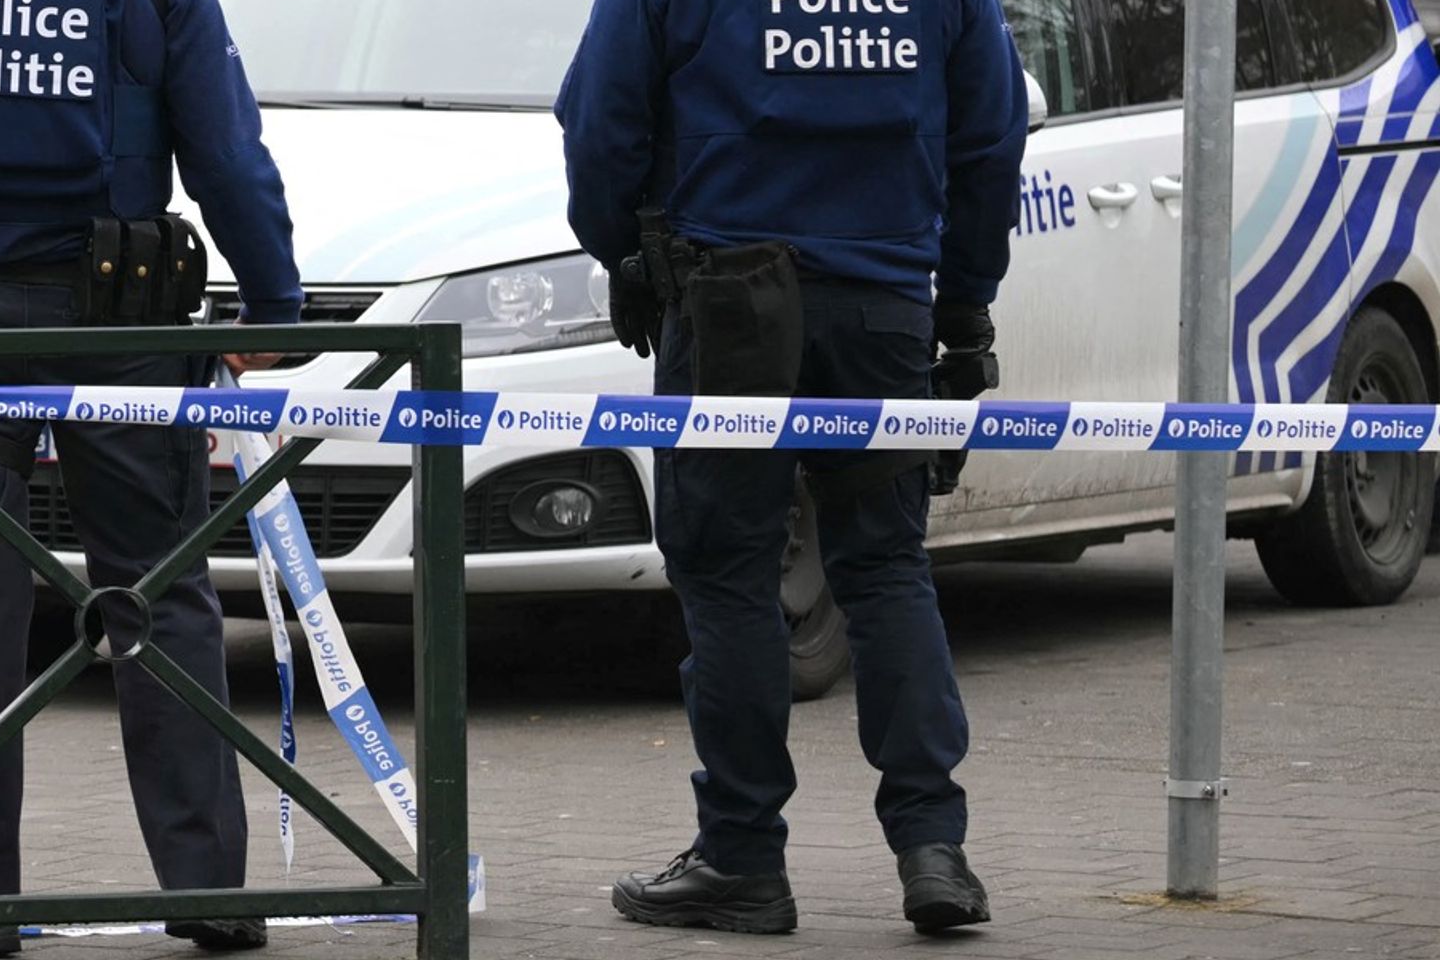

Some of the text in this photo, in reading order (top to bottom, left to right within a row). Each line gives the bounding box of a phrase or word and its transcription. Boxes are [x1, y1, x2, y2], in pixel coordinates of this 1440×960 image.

[764, 25, 918, 70] Politie
[1016, 169, 1076, 236] itie
[99, 402, 169, 423] Politie
[208, 403, 272, 426] Police
[312, 406, 381, 428] Politie
[421, 407, 482, 429] Police
[519, 410, 583, 431] Politie
[619, 411, 678, 433] Police
[713, 413, 777, 435] Politie
[813, 414, 869, 436] Police
[904, 416, 967, 437] Politie
[1002, 417, 1058, 438] Police
[1092, 418, 1153, 439] Politie
[1189, 419, 1243, 440] Police
[1276, 420, 1337, 440] Politie
[1371, 420, 1425, 440] Police
